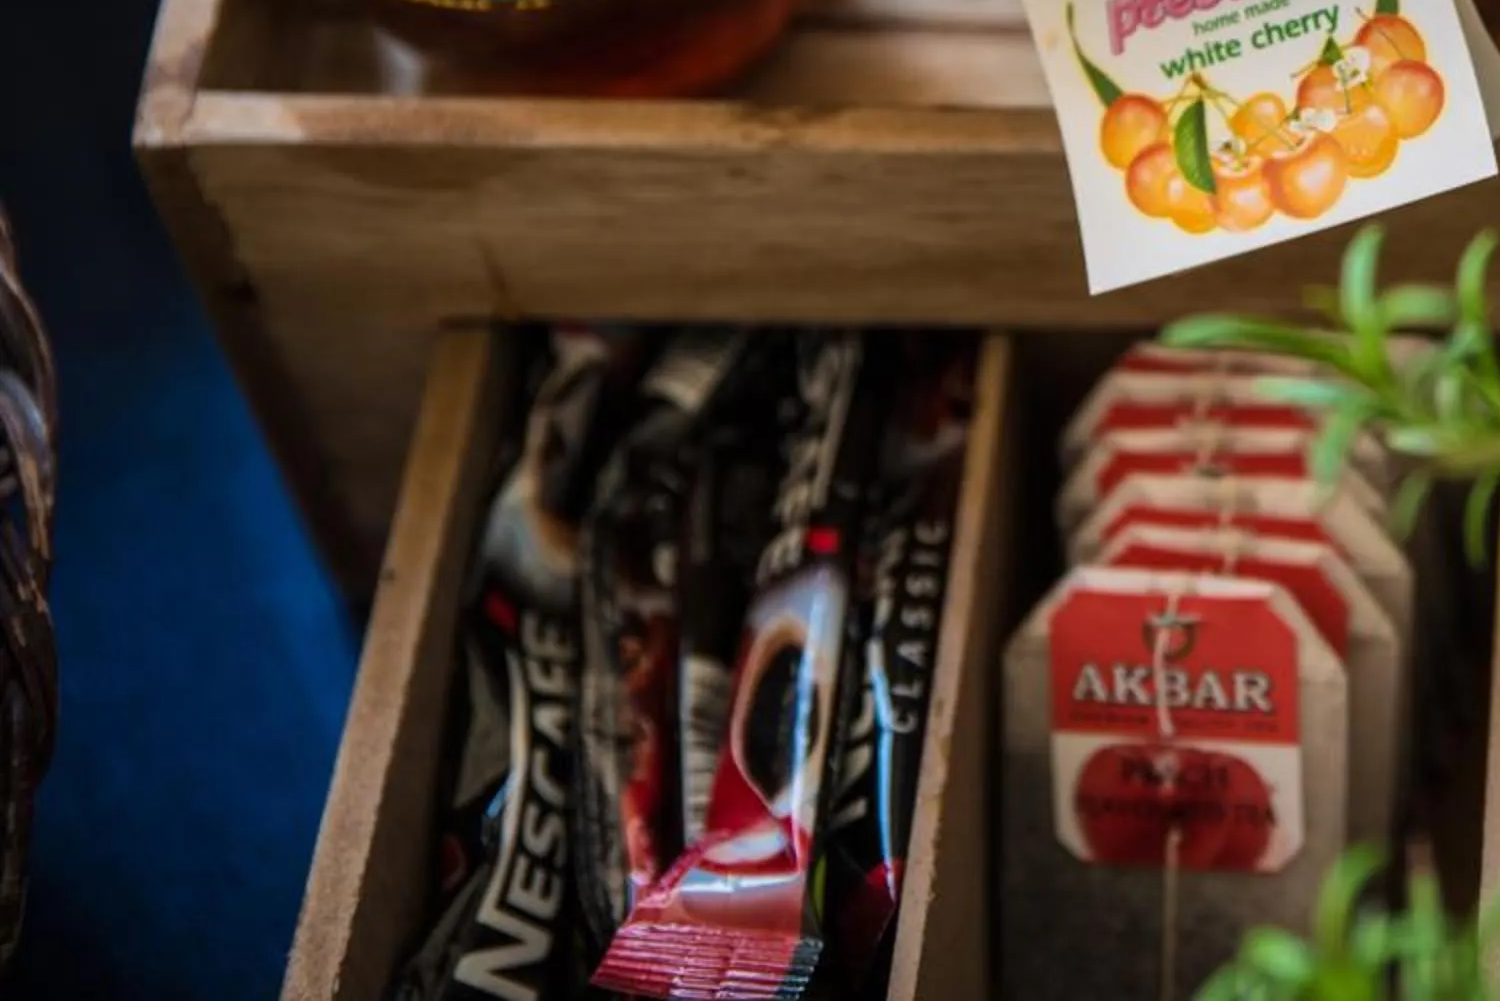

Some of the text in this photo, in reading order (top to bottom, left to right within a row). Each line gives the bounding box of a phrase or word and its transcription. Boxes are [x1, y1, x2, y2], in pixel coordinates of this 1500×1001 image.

[1160, 4, 1340, 80] white cherry
[1191, 9, 1240, 36] home
[891, 517, 951, 736] CLASSIC
[1071, 662, 1275, 713] AKBAR
